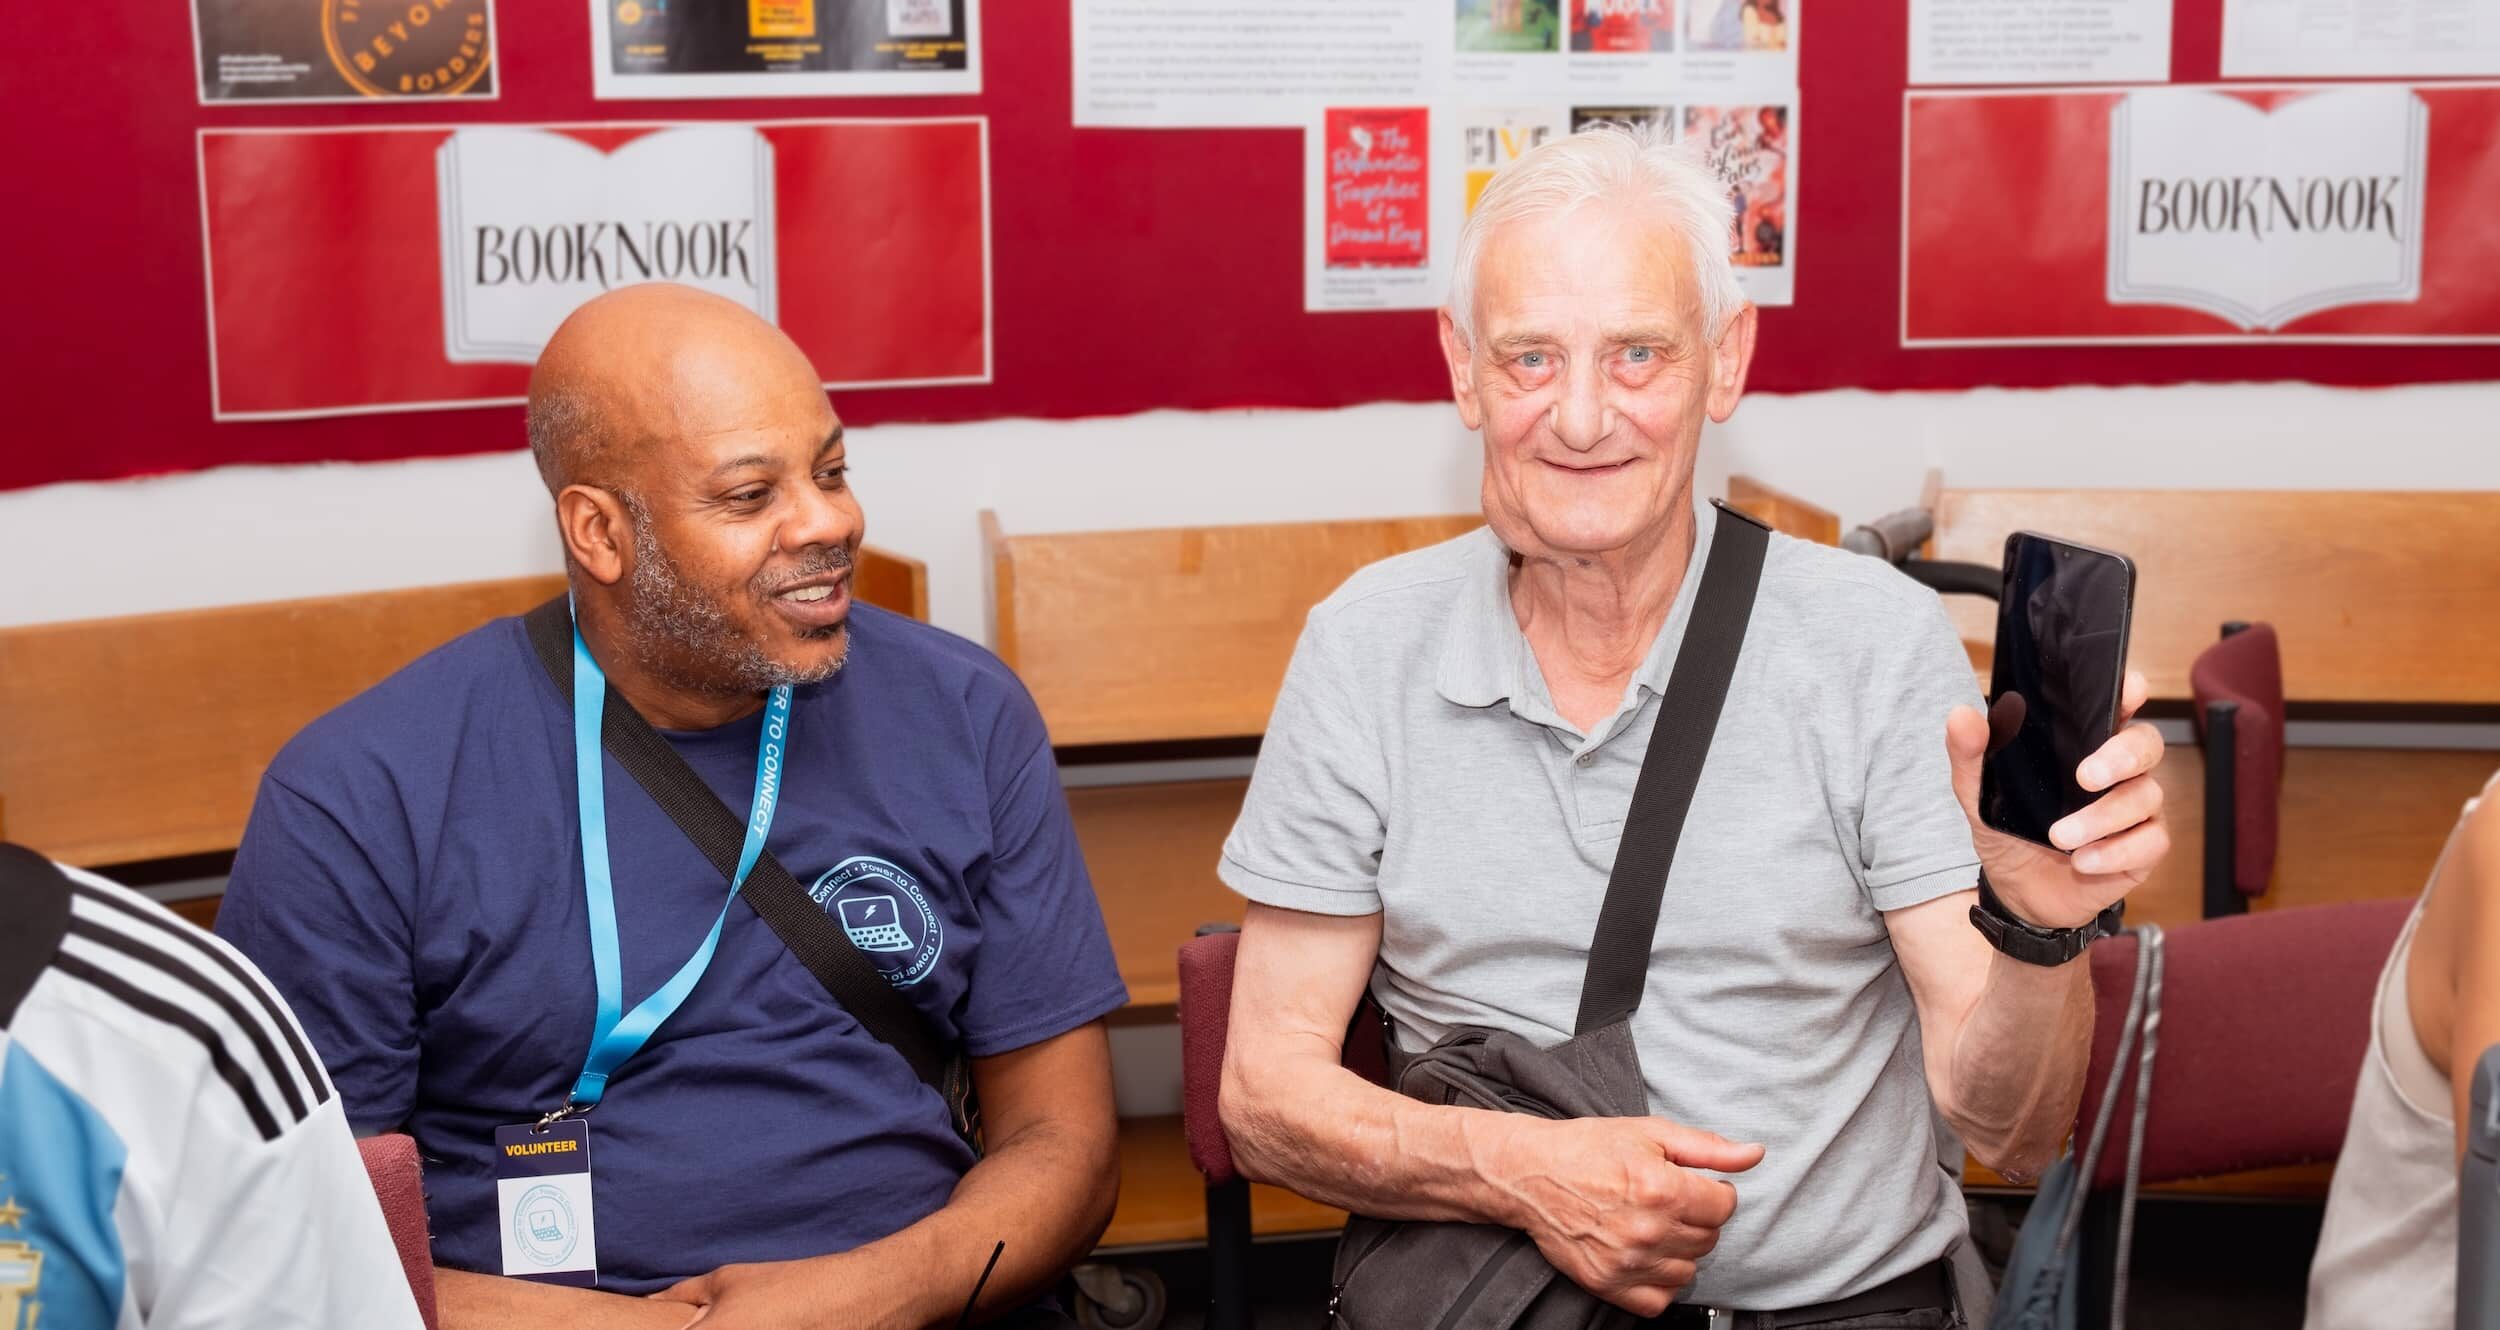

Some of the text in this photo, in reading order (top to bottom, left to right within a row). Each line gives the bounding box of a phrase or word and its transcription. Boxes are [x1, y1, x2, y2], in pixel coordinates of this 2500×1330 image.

[768, 714, 785, 740] TO
[752, 742, 780, 839] CONNECT
[813, 869, 853, 904] Connect
[860, 862, 895, 878] Power
[896, 875, 909, 888] to
[909, 884, 938, 935] Connect
[504, 1140, 578, 1157] VOLUNTEER
